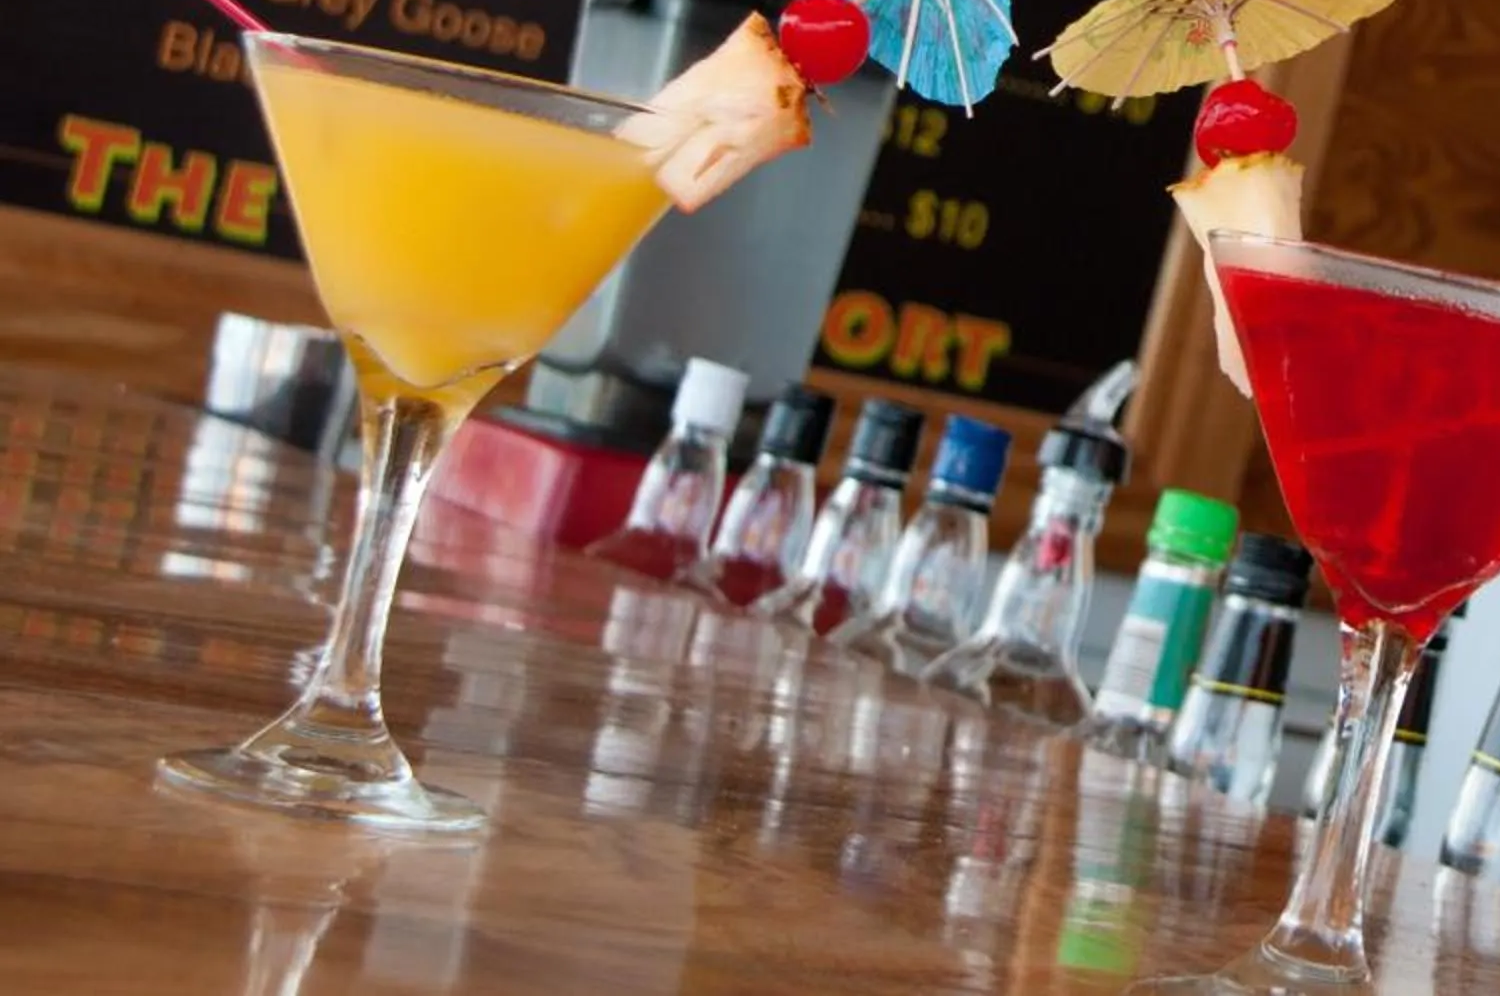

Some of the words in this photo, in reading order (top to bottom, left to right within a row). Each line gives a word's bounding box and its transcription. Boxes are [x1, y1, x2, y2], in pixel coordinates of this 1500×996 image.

[880, 106, 947, 156] 12
[904, 187, 990, 250] $10
[57, 111, 277, 243] THE
[819, 288, 1012, 392] ORT
